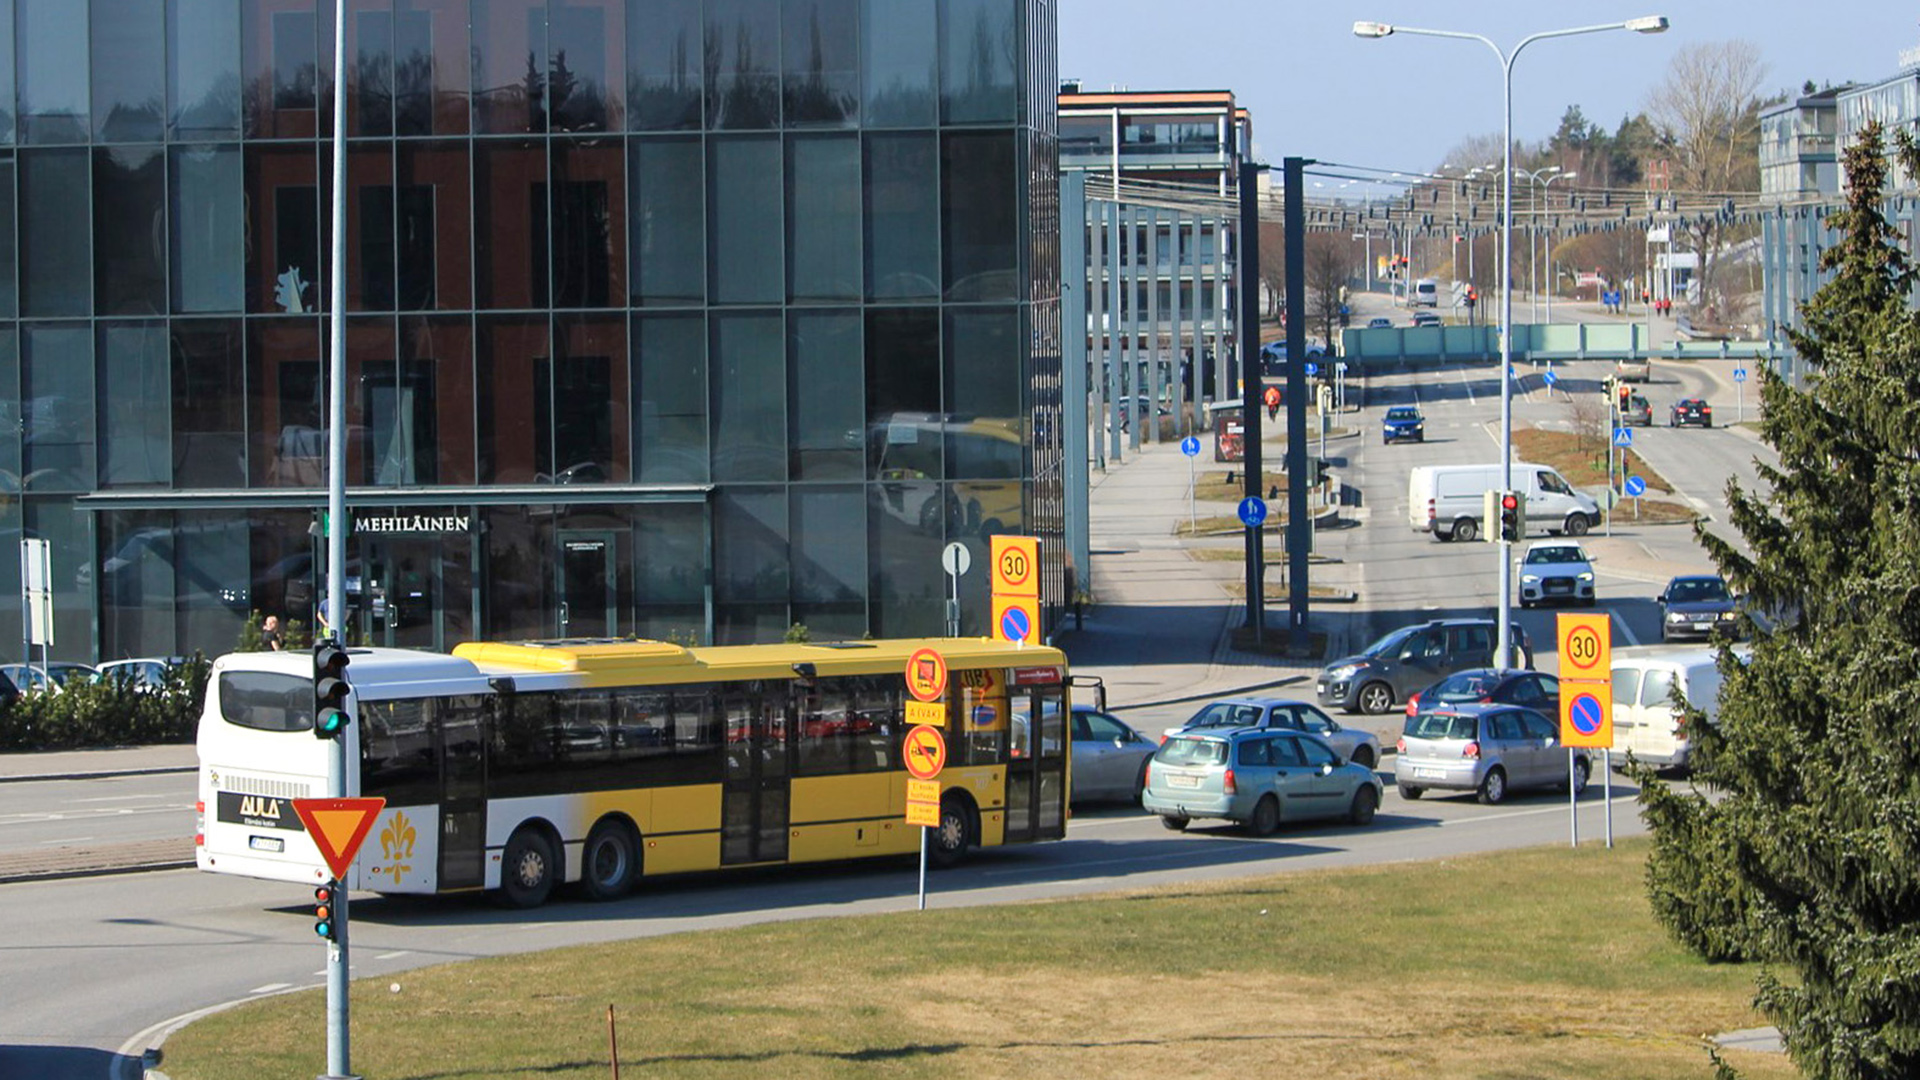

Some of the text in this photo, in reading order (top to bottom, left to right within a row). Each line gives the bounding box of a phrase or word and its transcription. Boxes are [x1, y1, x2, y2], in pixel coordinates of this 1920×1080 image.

[354, 515, 469, 532] MEHILÄINEN
[1004, 556, 1024, 576] 30
[1573, 636, 1595, 658] 30
[240, 796, 280, 819] AULA
